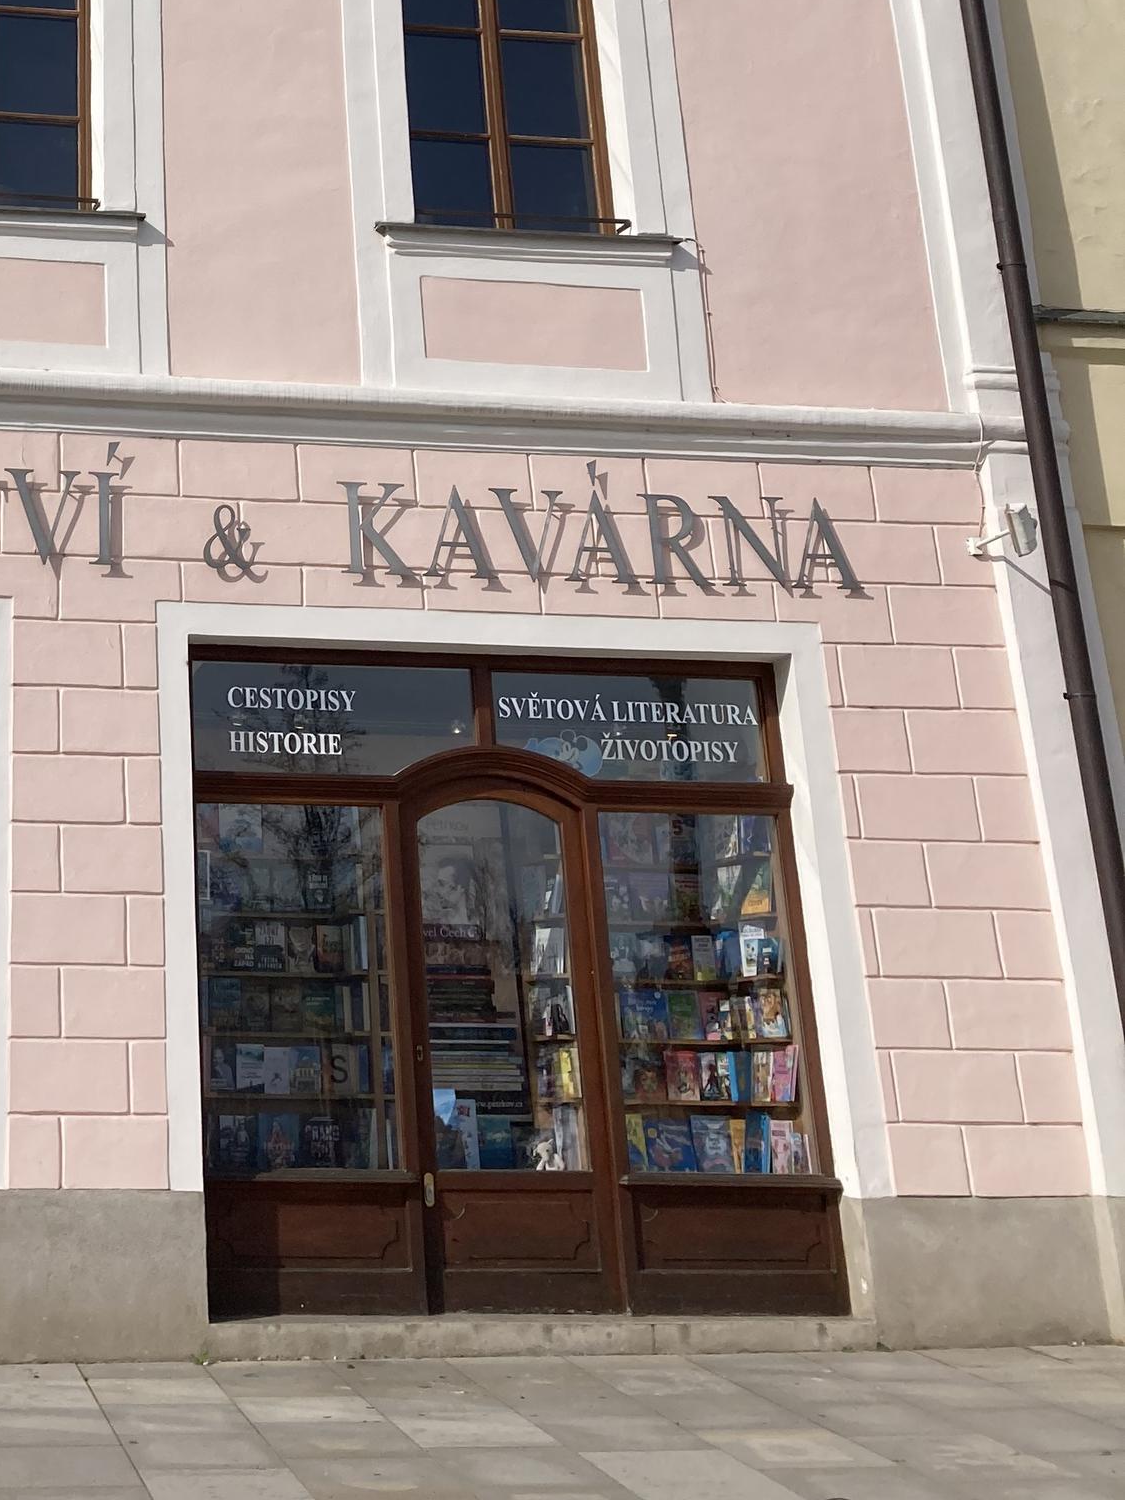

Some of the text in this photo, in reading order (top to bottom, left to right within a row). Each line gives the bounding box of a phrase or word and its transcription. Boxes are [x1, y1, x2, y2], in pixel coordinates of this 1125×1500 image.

[203, 505, 251, 569] &
[337, 460, 864, 593] KAVÁRNA
[227, 686, 356, 712] CESTOPISY
[498, 692, 758, 725] SVĚTOVÁ LITERATURA
[228, 731, 343, 755] HISTORIE
[600, 732, 738, 763] ŽIVOTOPISY
